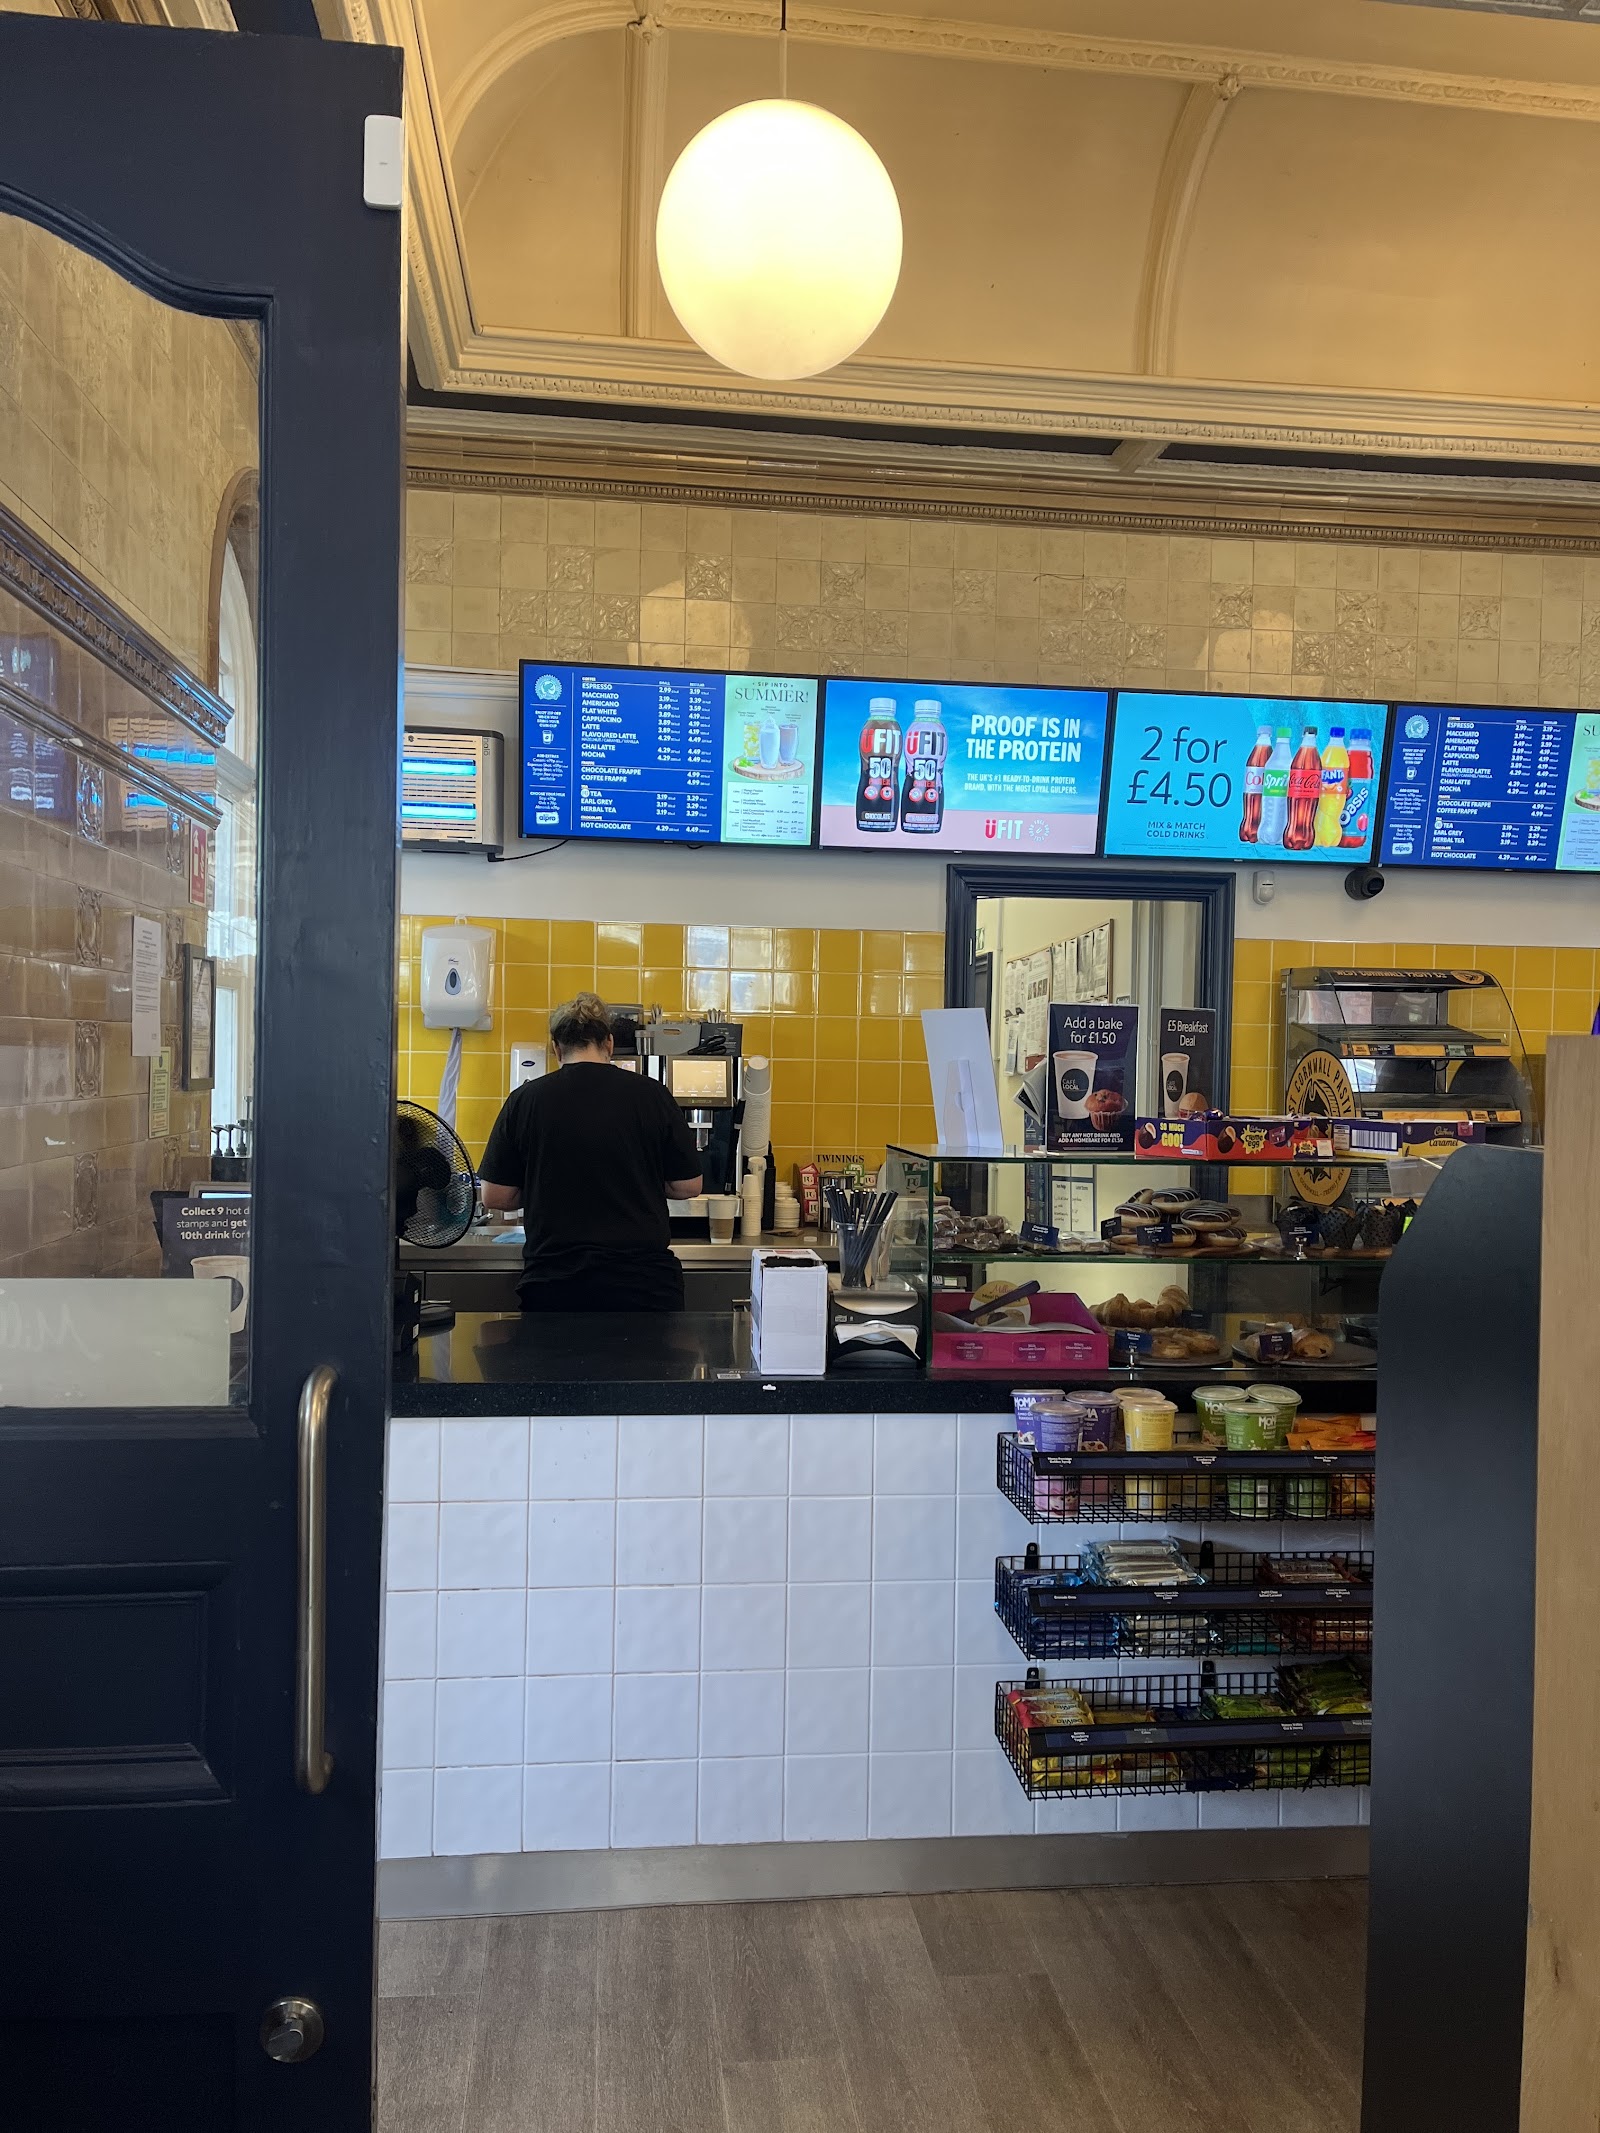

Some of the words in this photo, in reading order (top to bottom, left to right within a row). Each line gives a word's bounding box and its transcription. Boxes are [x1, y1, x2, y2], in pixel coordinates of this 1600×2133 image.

[735, 687, 809, 703] SUMMER!
[582, 715, 622, 723] CAPPUCCINO
[970, 714, 1037, 737] PROOF
[1041, 717, 1061, 739] IS
[1064, 718, 1081, 739] IN
[582, 731, 618, 739] FLAVOURED
[618, 732, 637, 740] LATTE
[966, 737, 996, 760] THE
[999, 739, 1082, 763] PROTEIN
[1140, 725, 1163, 762] 2
[1172, 726, 1228, 764] for
[1443, 752, 1480, 760] CAPPUCCINO
[604, 775, 627, 783] FRAPPE
[967, 773, 978, 781] THE
[980, 774, 993, 782] UK'S
[994, 774, 1001, 782] #1
[1002, 775, 1050, 784] READY-TO-DRINK
[1051, 776, 1076, 785] PROTEIN
[1321, 769, 1345, 780] FANTA
[964, 783, 986, 792] BRAND,
[987, 784, 1002, 792] WITH
[1003, 784, 1014, 792] THE
[1015, 785, 1031, 793] MOST
[1032, 785, 1049, 793] LOYAL
[1050, 786, 1078, 795] GULPERS.
[1126, 769, 1232, 808] £4.50
[538, 815, 556, 823] alpro
[865, 812, 891, 820] CHOCOLATE
[595, 822, 632, 830] CHOCOLATE
[984, 819, 1023, 840] ÜFIT
[1148, 821, 1164, 831] MIX
[1166, 822, 1173, 831] &
[1174, 822, 1206, 832] MATCH
[1146, 830, 1171, 839] COLD
[1172, 830, 1206, 840] DRINKS
[1064, 1017, 1087, 1030] Add
[1088, 1020, 1095, 1030] a
[1097, 1017, 1123, 1030] bake
[1167, 1020, 1177, 1032] £5
[1177, 1020, 1209, 1034] Breakfast
[1070, 1031, 1087, 1044] for
[1088, 1031, 1117, 1045] £1.50
[1179, 1034, 1196, 1047] Deal
[1294, 1057, 1332, 1093] CORNWALL
[1333, 1070, 1352, 1115] PASTY
[1160, 1122, 1168, 1130] SO
[1168, 1123, 1185, 1132] MUCH
[1161, 1132, 1184, 1149] GOO!
[1429, 1138, 1459, 1147] Caramel
[816, 1154, 865, 1163] TWININGS
[181, 1207, 215, 1216] Collect
[217, 1206, 224, 1215] 9
[226, 1207, 242, 1215] hot
[176, 1220, 210, 1229] stamps
[211, 1219, 229, 1227] and
[230, 1219, 247, 1229] get
[181, 1231, 203, 1240] 10th
[204, 1231, 230, 1239] drink
[231, 1230, 245, 1239] for
